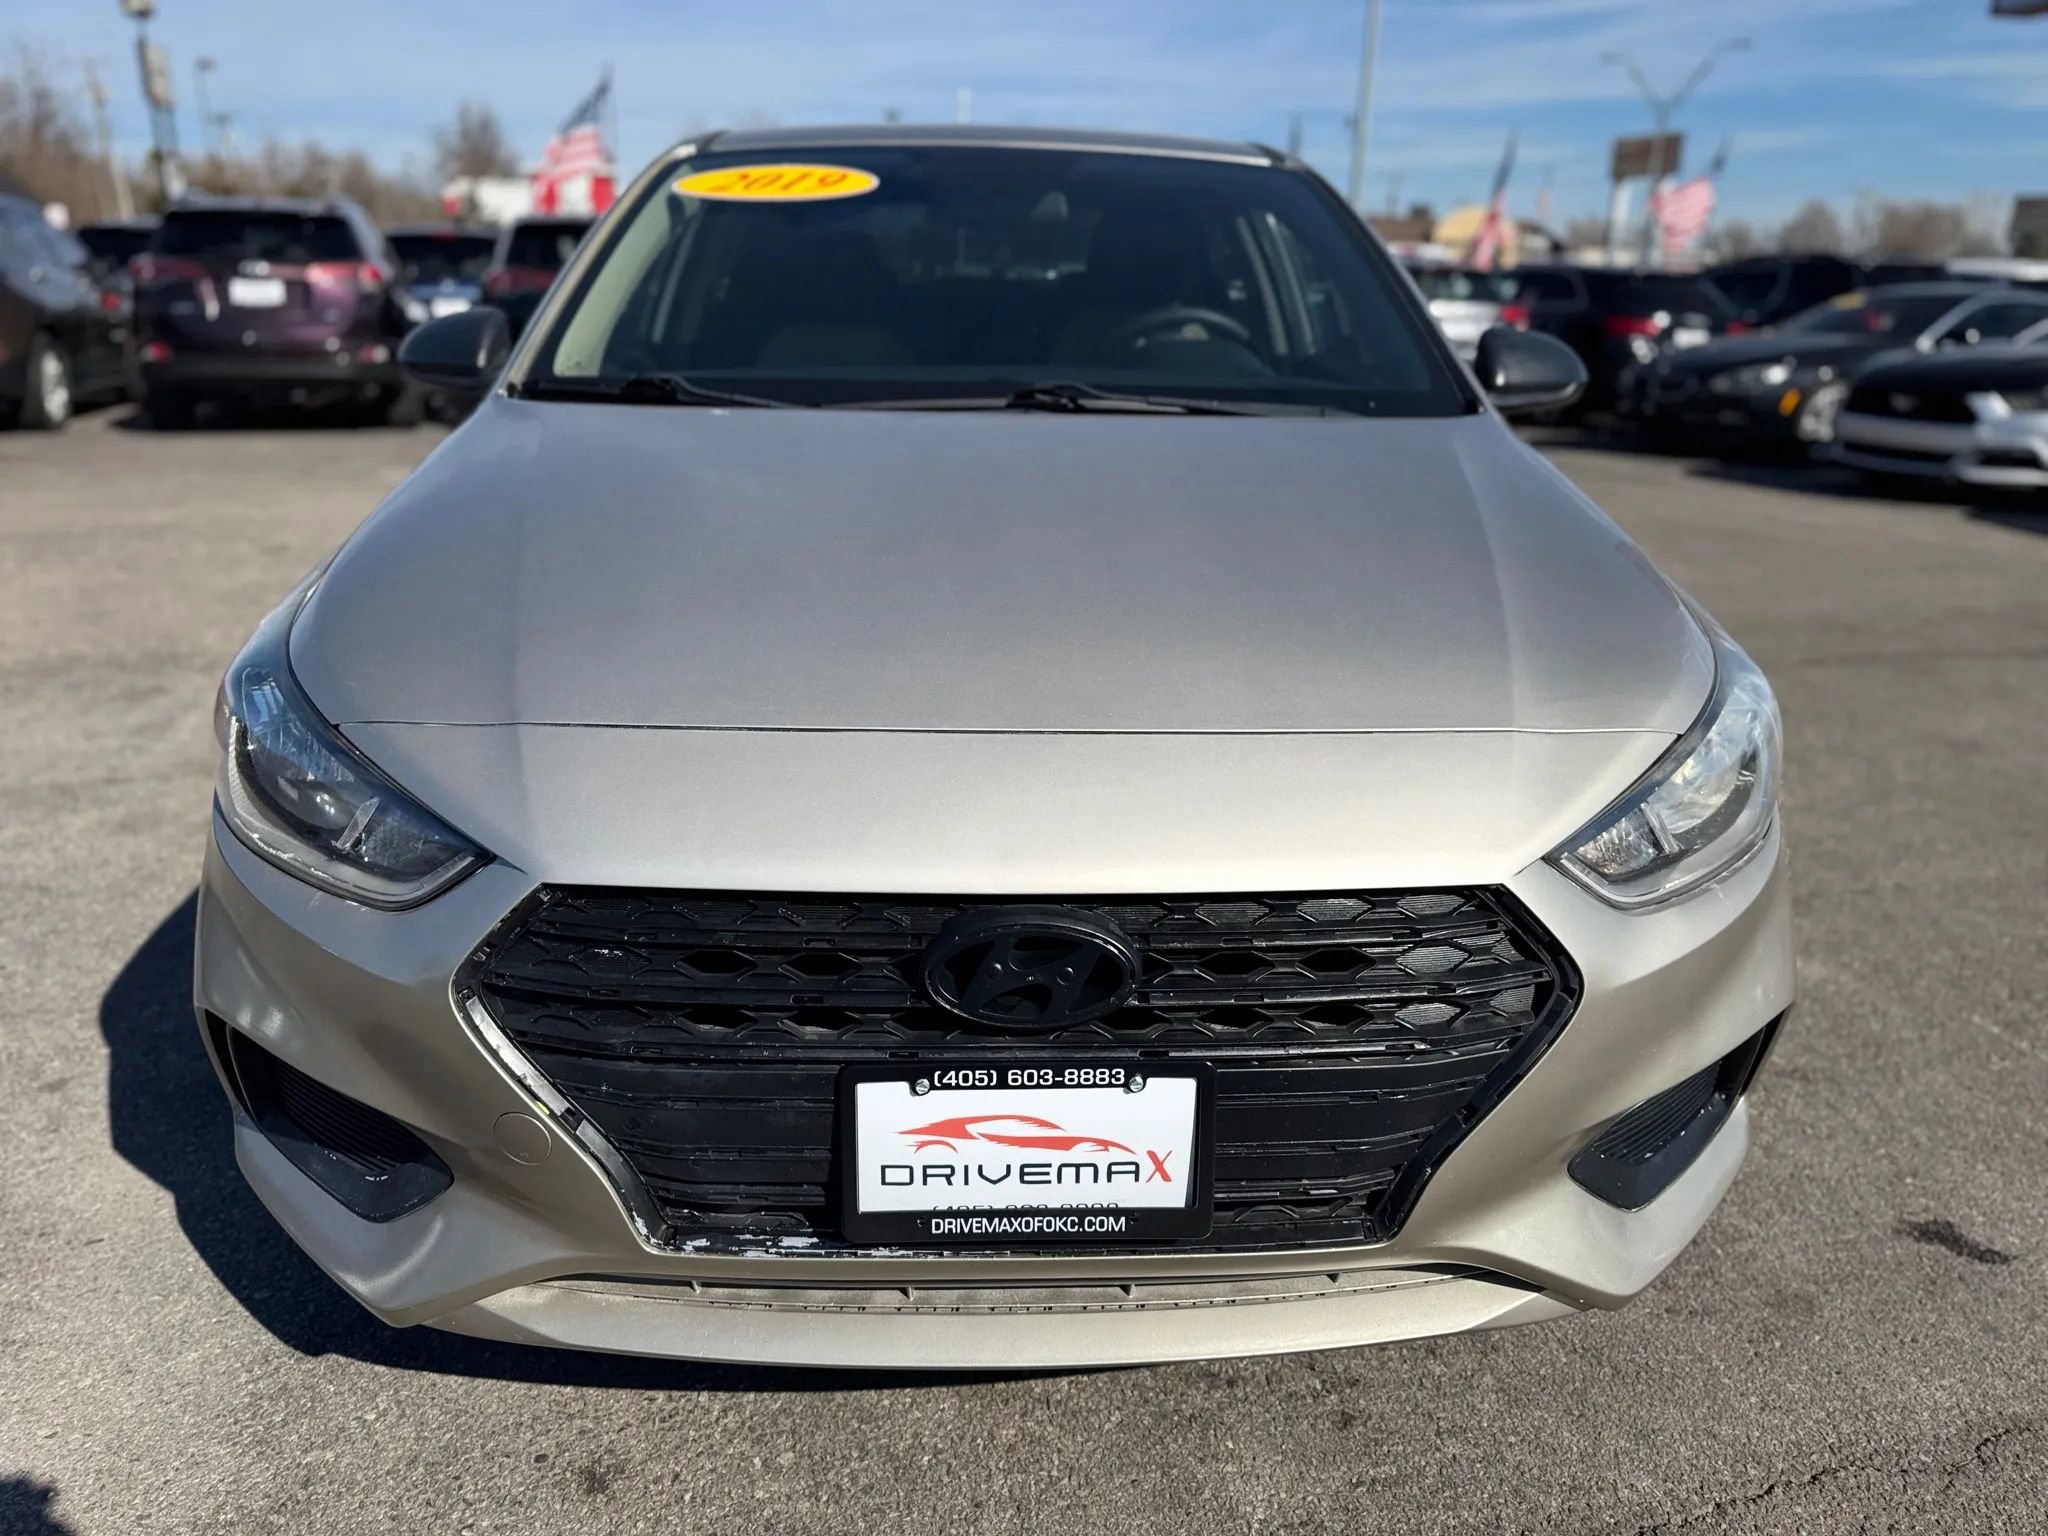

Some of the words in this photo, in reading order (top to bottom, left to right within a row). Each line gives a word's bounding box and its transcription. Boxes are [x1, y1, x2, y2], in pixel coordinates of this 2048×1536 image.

[705, 171, 848, 193] 2019
[933, 1069, 998, 1087] (405)
[1007, 1068, 1126, 1086] 603-8883
[880, 1149, 1174, 1186] DRIVEMAX
[931, 1216, 1126, 1234] DRIVEMAXOFOKC.COM
